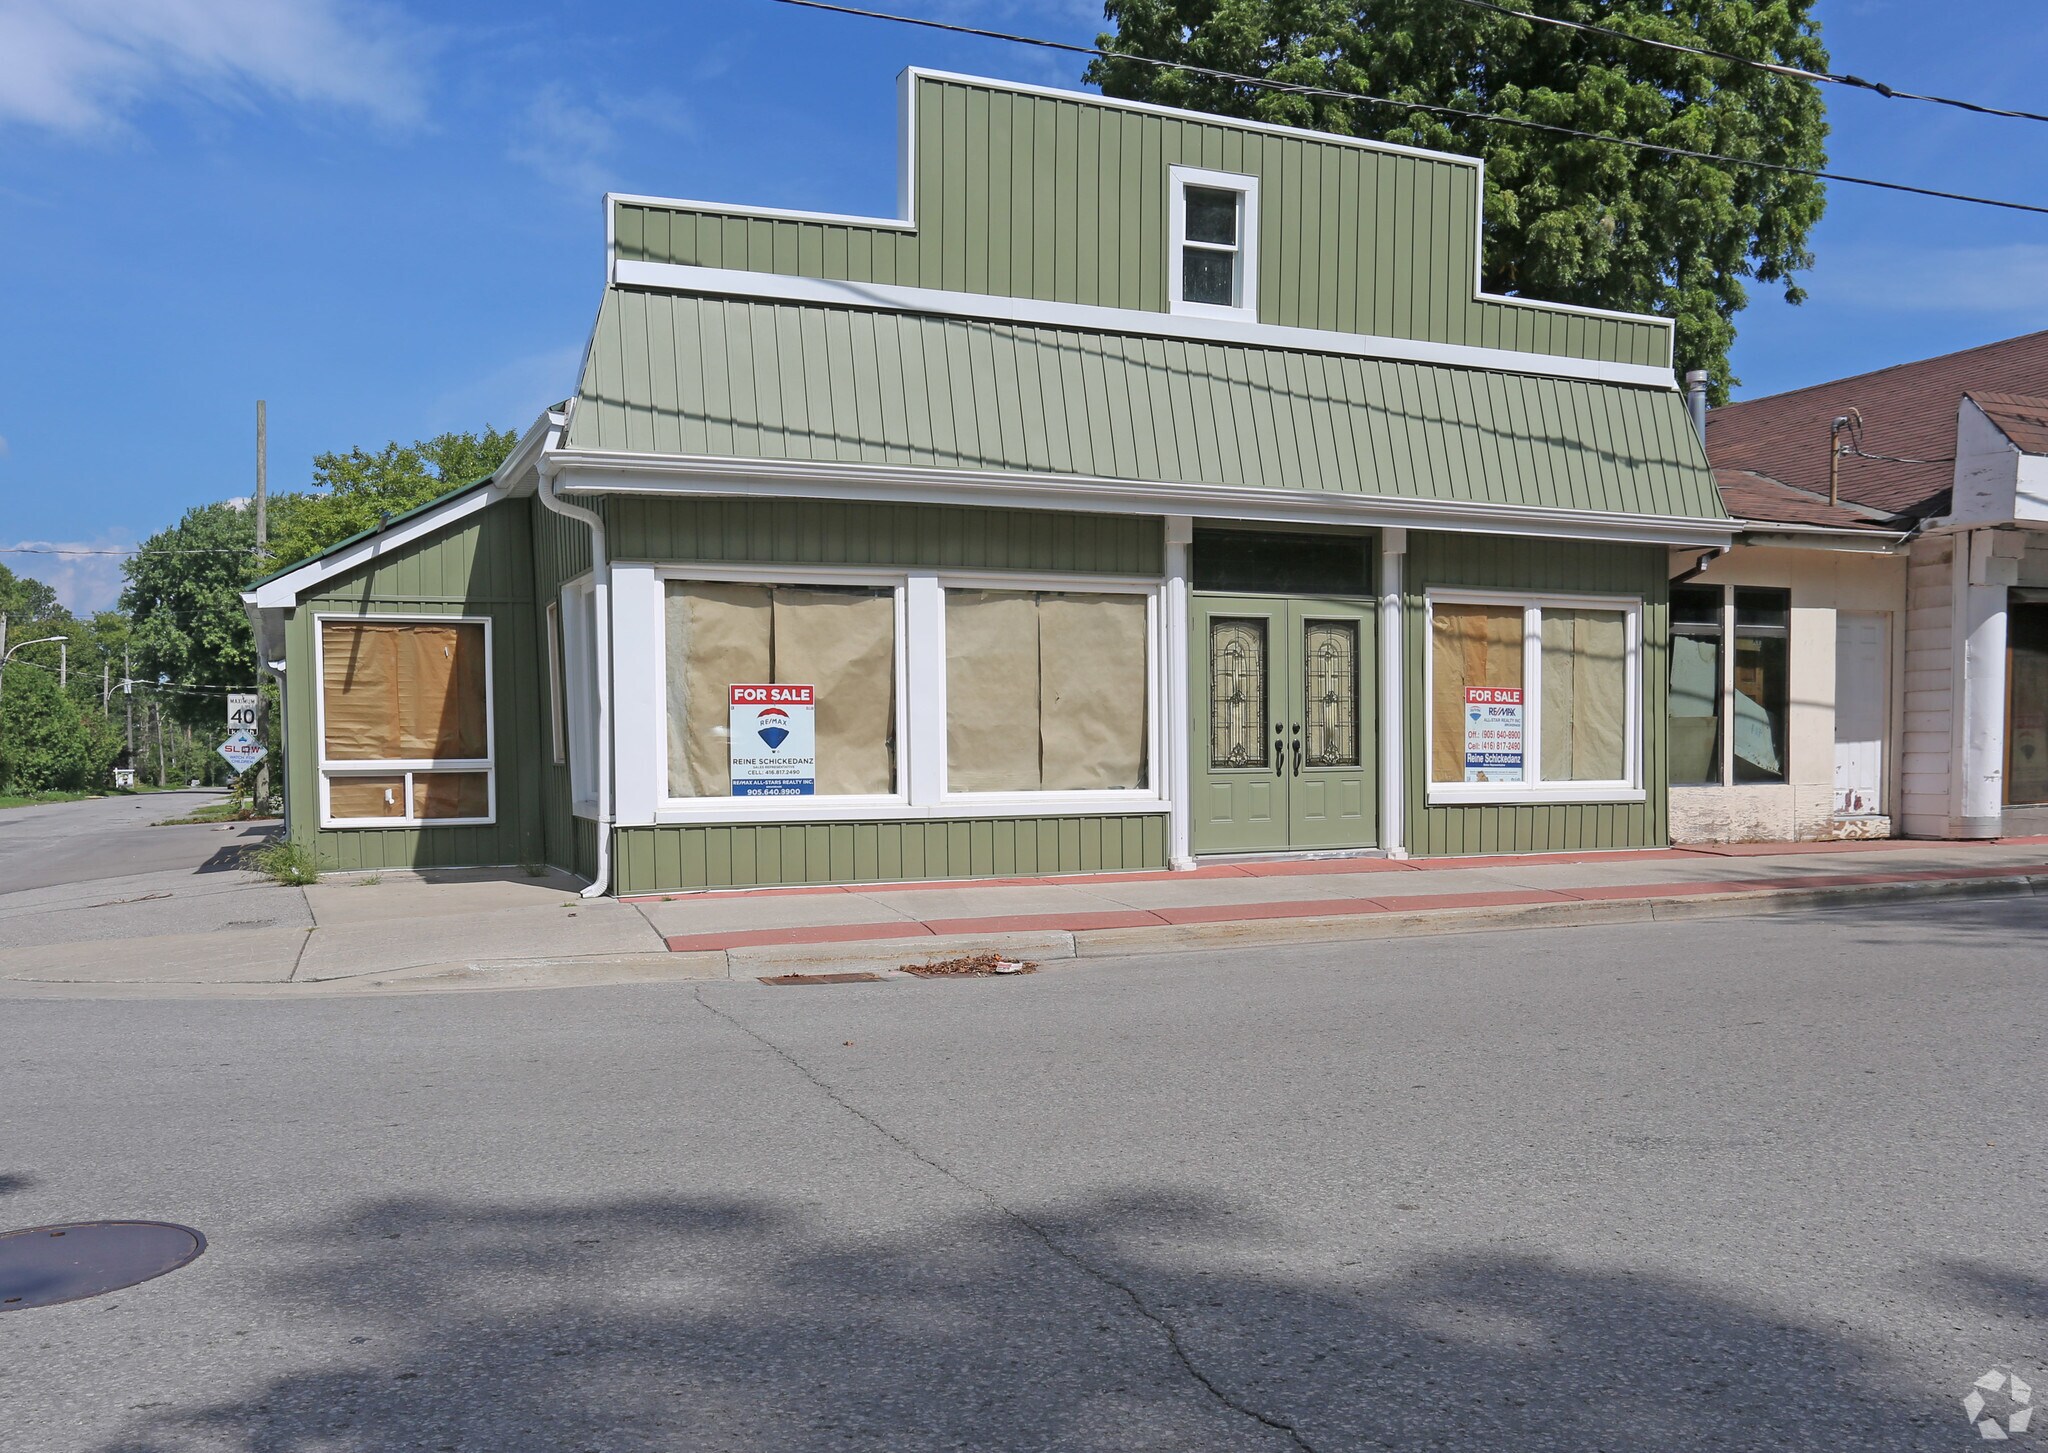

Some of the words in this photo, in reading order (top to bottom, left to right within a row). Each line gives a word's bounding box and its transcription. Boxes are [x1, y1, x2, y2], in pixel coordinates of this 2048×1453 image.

[734, 688, 767, 701] FOR
[770, 688, 811, 701] SALE
[1469, 690, 1492, 702] FOR
[1494, 690, 1520, 702] SALE
[1488, 707, 1516, 716] RE/MAX
[231, 709, 255, 724] 40
[759, 718, 787, 726] RE/MAX
[1482, 730, 1496, 739] (905)
[224, 745, 260, 753] SLOW
[1482, 741, 1496, 750] (416)
[1496, 741, 1521, 750] 817-2490
[1466, 753, 1484, 763] Reine
[1484, 753, 1521, 764] Schickedanz
